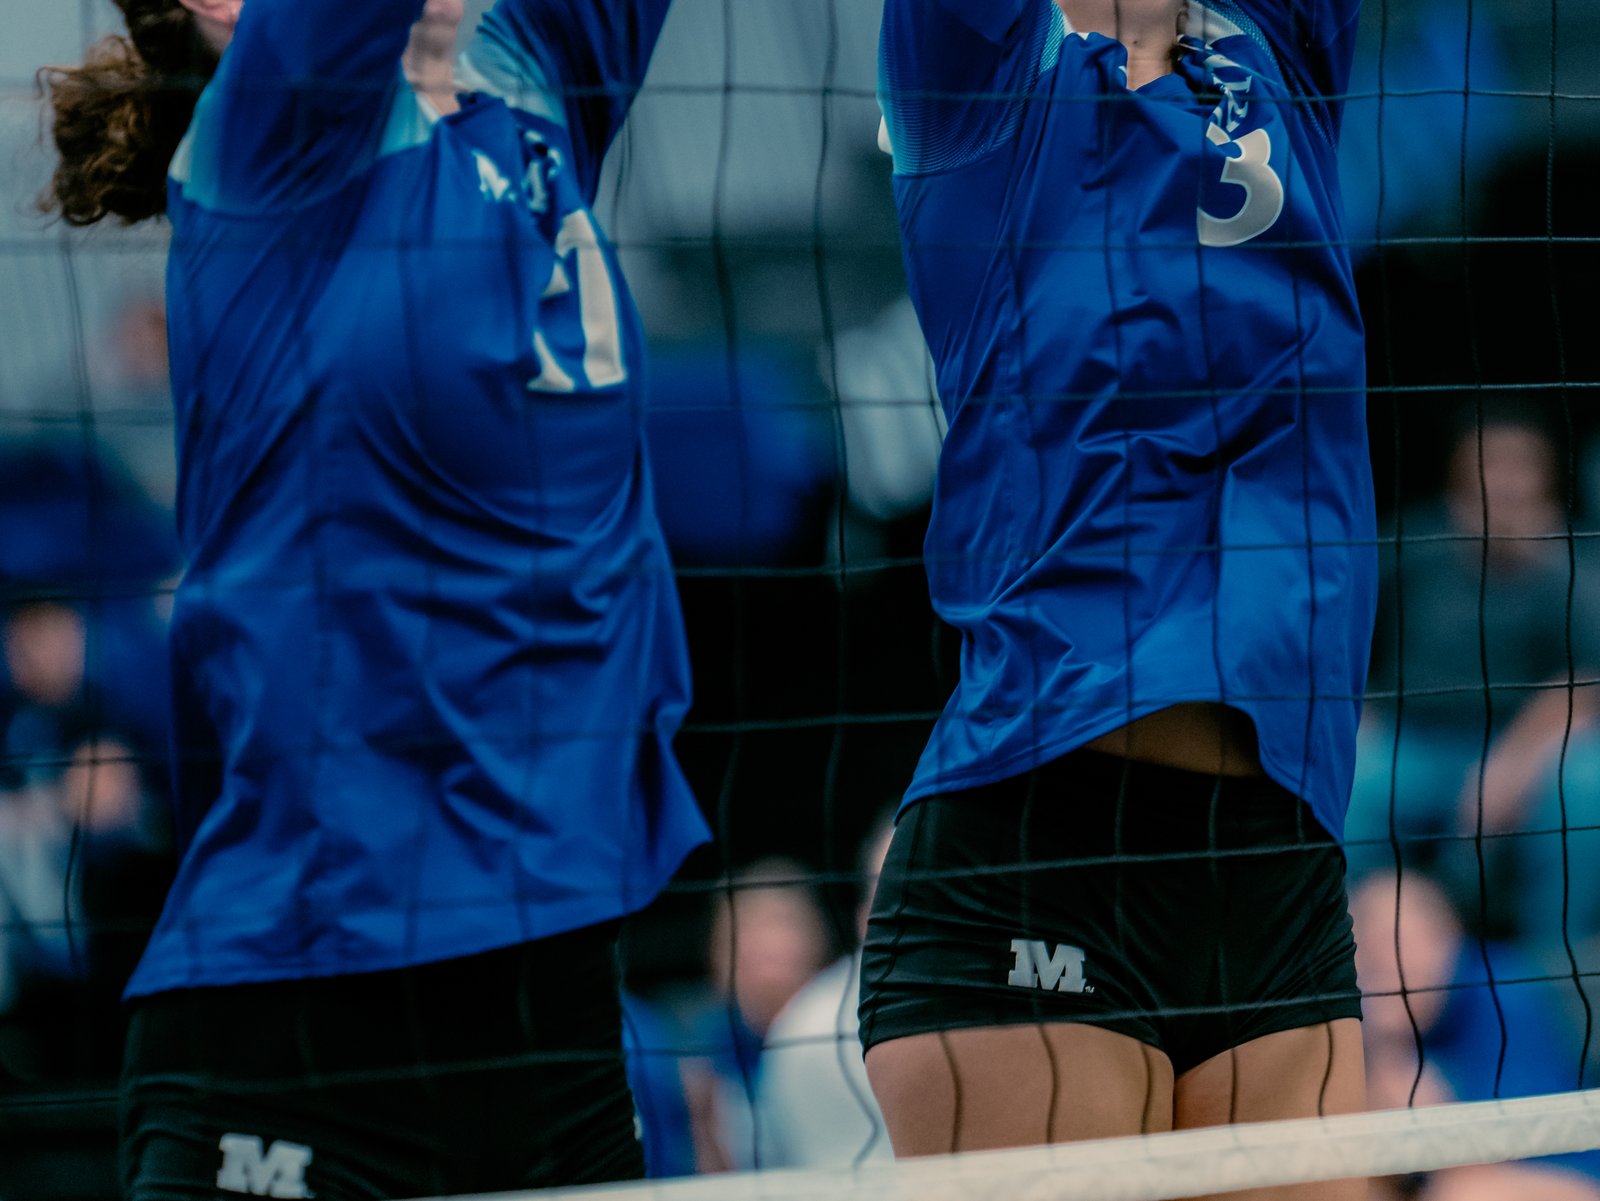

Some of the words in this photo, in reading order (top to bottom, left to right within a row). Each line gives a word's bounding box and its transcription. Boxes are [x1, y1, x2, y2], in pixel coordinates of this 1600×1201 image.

[1197, 123, 1284, 247] 3
[1008, 939, 1087, 994] M
[216, 1132, 313, 1200] M
